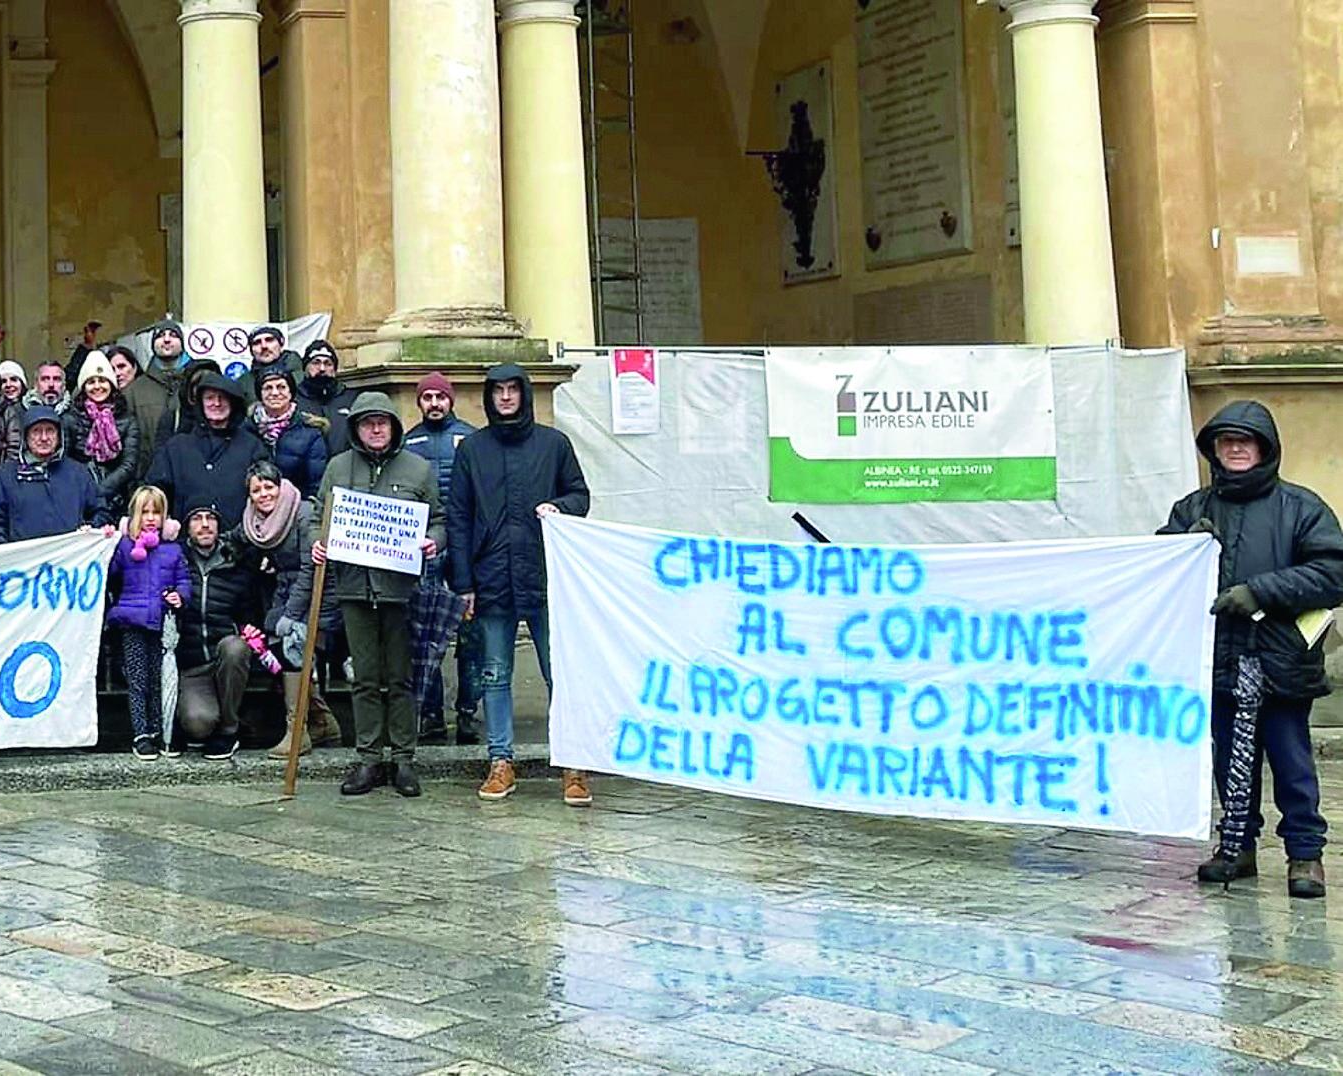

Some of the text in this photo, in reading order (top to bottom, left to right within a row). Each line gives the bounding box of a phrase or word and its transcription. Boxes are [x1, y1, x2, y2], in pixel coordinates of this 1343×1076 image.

[863, 390, 988, 413] ZULIANI
[863, 414, 975, 428] IMPRESA EDILE
[333, 504, 420, 529] CONGESTIONAMENTO
[341, 494, 415, 517] DARE RISPOSTE AL
[333, 515, 347, 526] DEL
[349, 517, 387, 533] TRAFFICO
[398, 528, 417, 540] UNA
[345, 529, 403, 548] QUESTIONE DI
[372, 545, 414, 561] GIUSTIZIA
[654, 536, 924, 597] CHIEDIAMO
[736, 602, 1088, 668] AL COMUNE
[639, 660, 679, 713] IL
[612, 719, 754, 781] DELLA
